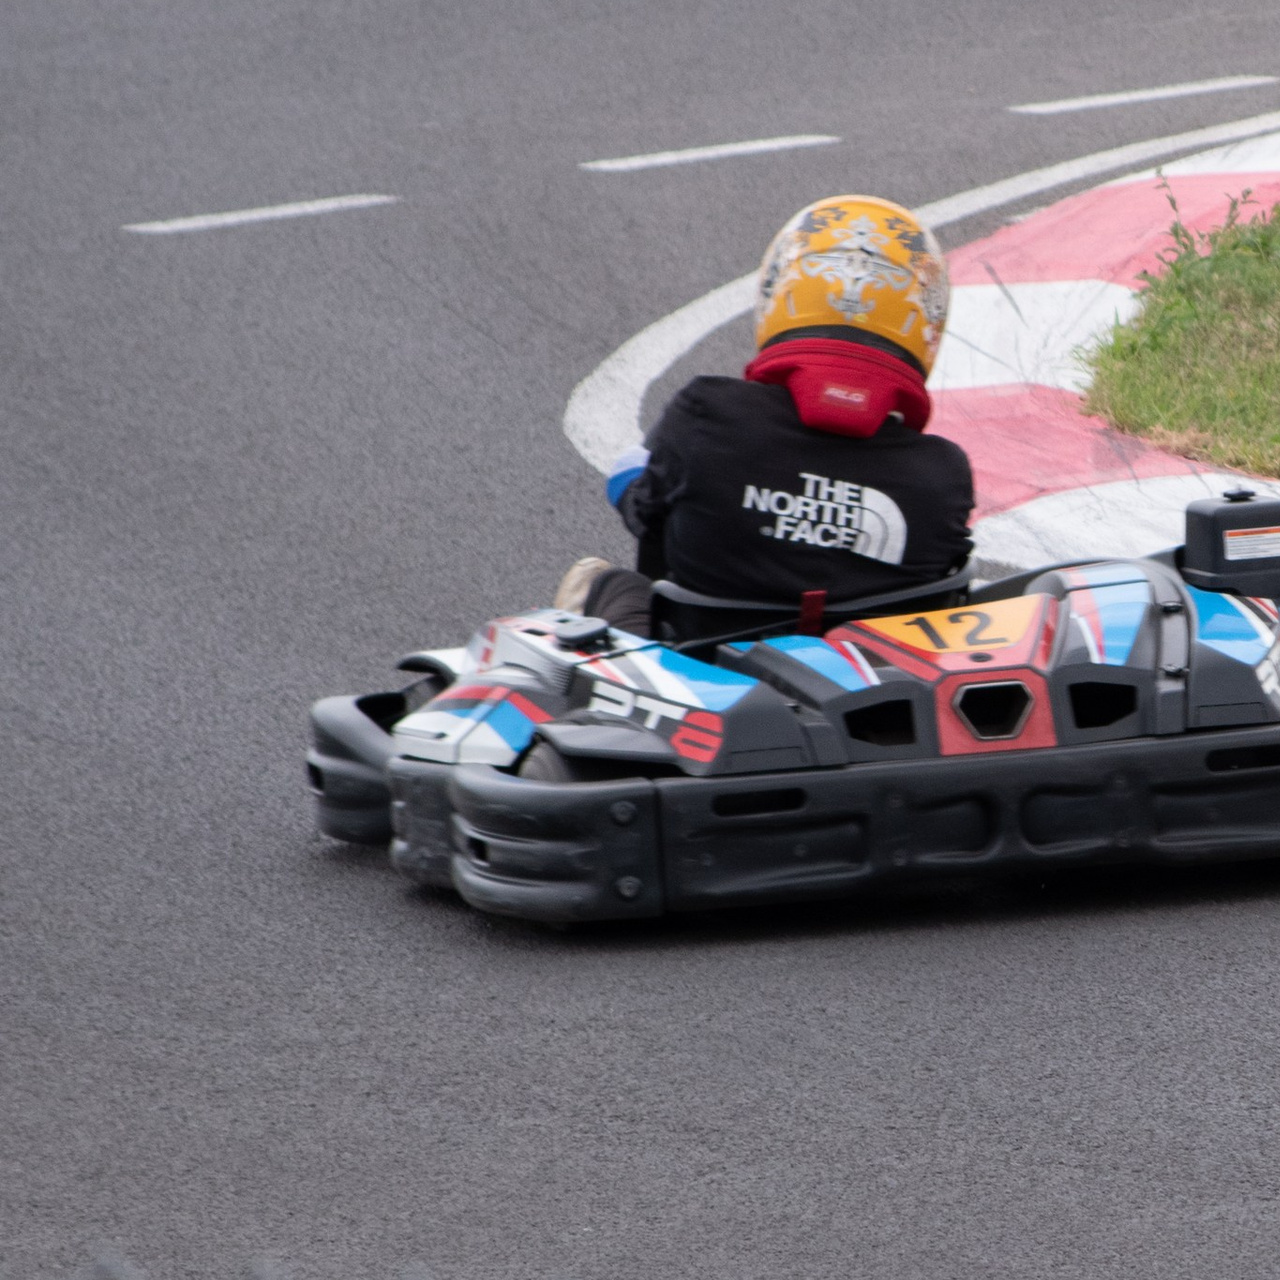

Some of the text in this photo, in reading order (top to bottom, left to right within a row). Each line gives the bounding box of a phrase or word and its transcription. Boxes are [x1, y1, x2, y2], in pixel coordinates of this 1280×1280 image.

[742, 485, 862, 531] NORTH
[799, 472, 863, 507] THE
[774, 516, 860, 549] FACE
[903, 611, 1009, 650] 12
